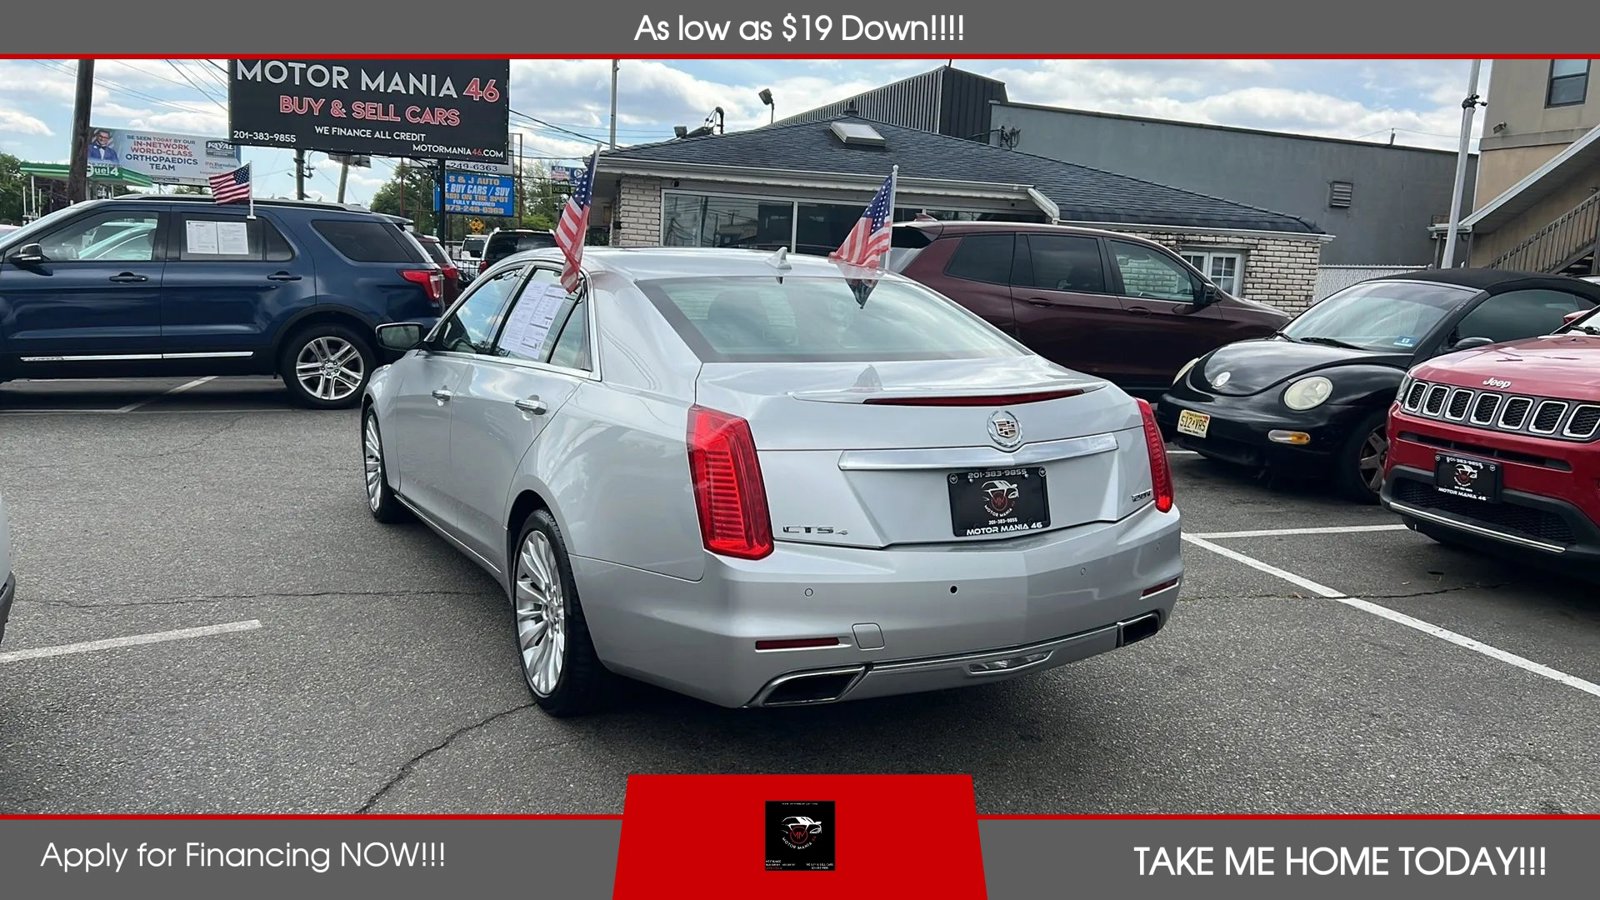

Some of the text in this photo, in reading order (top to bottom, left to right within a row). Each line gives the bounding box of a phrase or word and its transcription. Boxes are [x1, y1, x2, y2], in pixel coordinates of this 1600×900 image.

[236, 59, 500, 103] MOTOR MANIA 46
[279, 95, 460, 127] BUY & SELL CARS
[233, 130, 297, 143] 201-383-9855
[314, 125, 426, 142] WE FINANCE ALL CREDIT
[133, 140, 189, 150] IN-NETWORK
[412, 143, 504, 158] MOTORMANIA46.COM
[131, 147, 193, 157] WORLD-CLASS
[125, 153, 199, 165] ORTHOPAEDICS
[149, 163, 176, 171] TEAM
[451, 183, 467, 193] BUY
[467, 184, 488, 195] CARS
[494, 187, 511, 197] SUV
[1482, 377, 1512, 389] Jeep
[967, 468, 1027, 479] 201-383-9855
[1438, 487, 1458, 495] MOTOR
[1457, 491, 1478, 499] MANIA
[782, 525, 834, 534] CTS
[966, 521, 1043, 536] MOTOR MANIA 46
